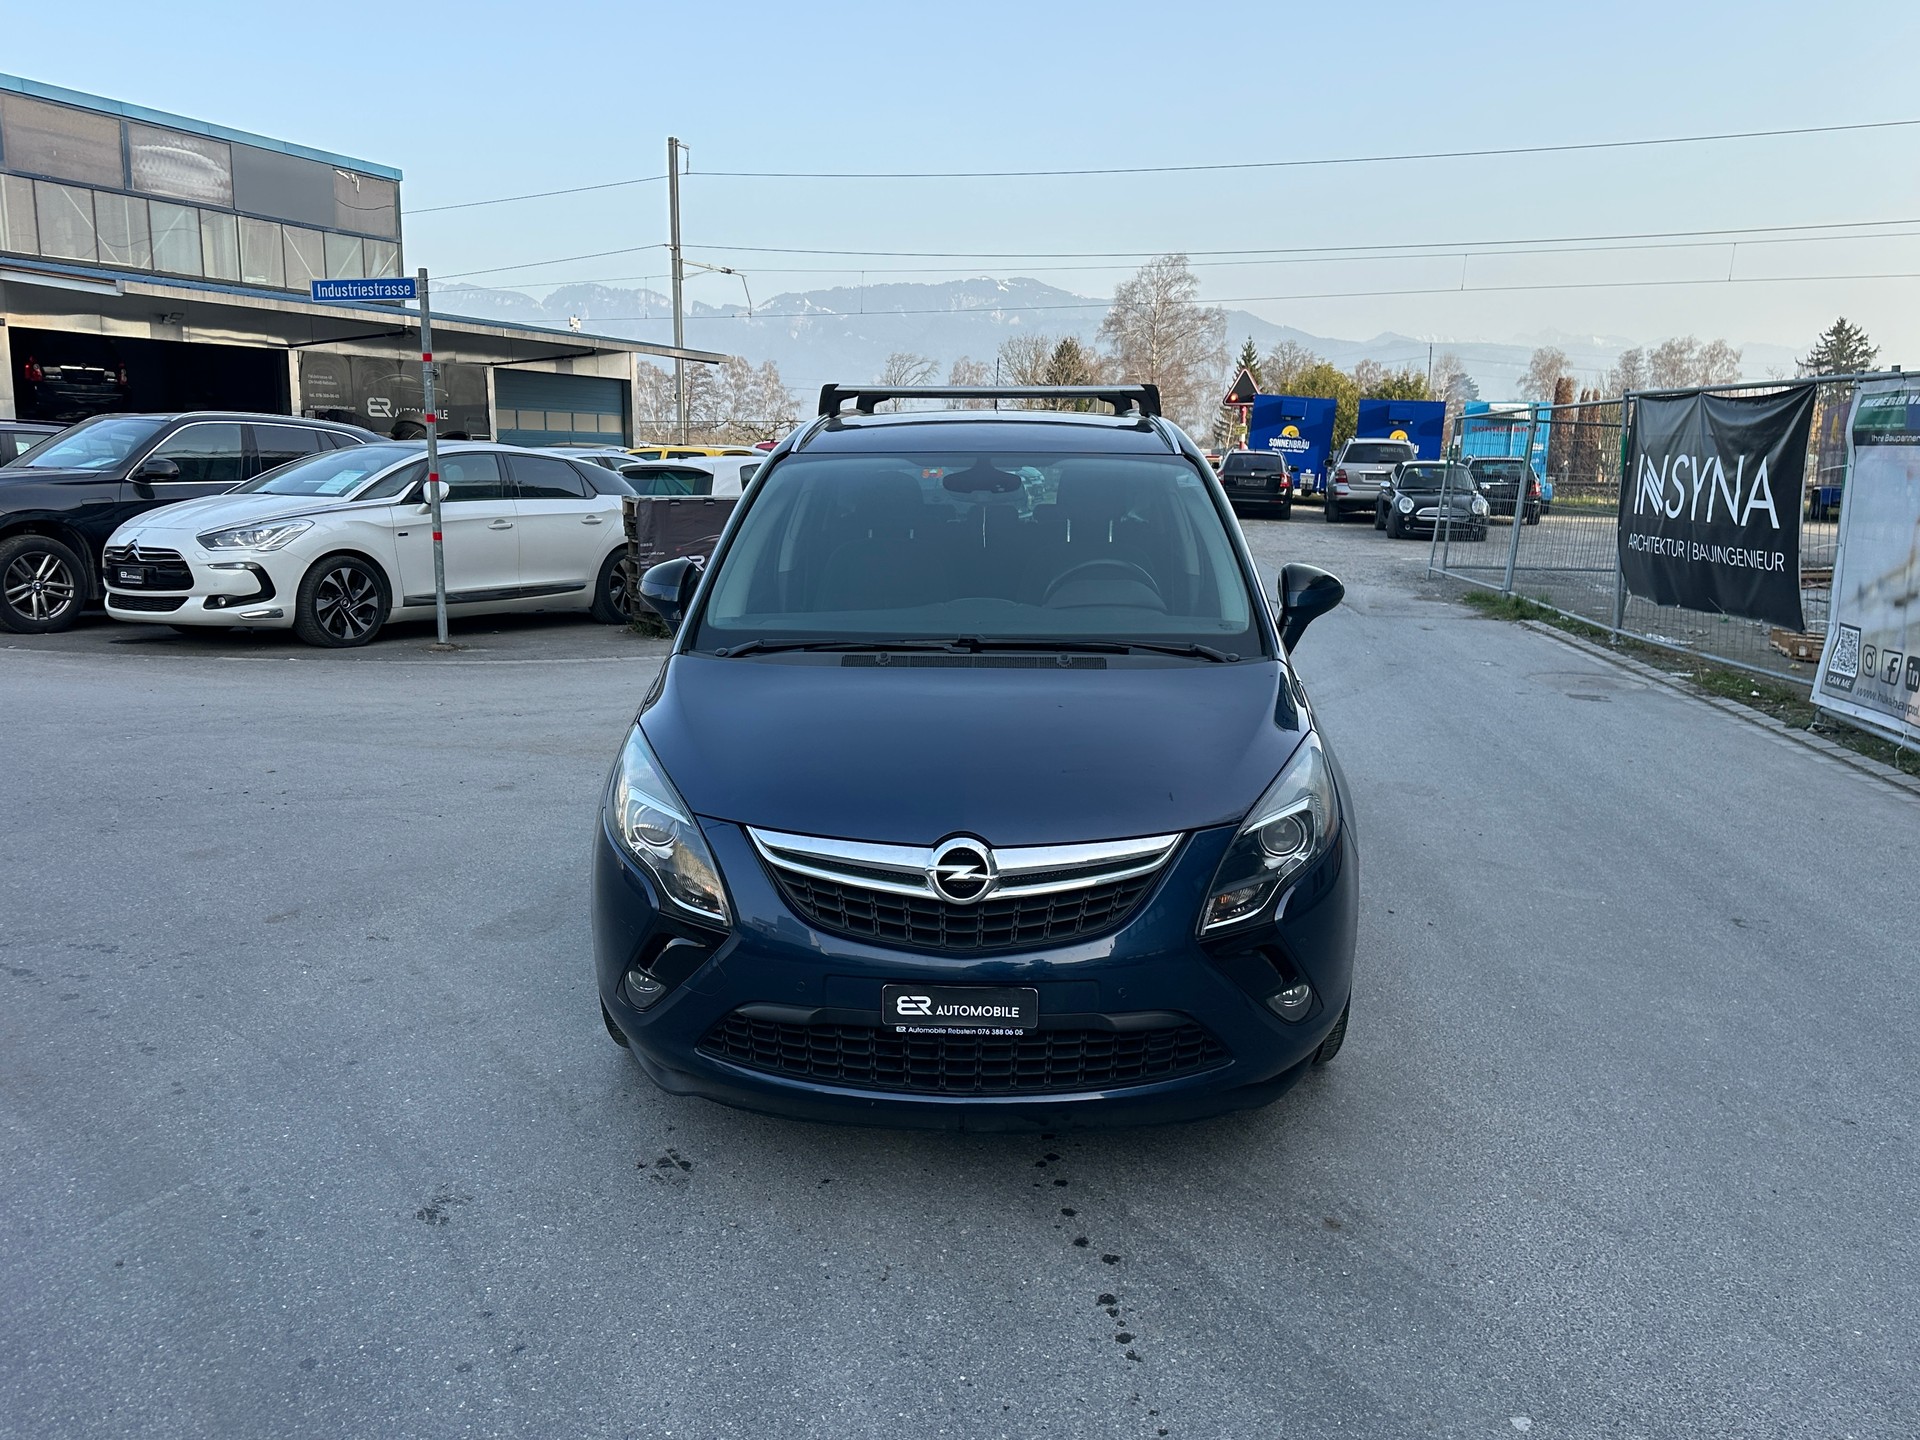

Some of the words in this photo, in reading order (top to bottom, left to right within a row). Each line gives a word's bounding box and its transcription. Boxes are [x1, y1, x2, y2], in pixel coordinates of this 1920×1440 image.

[317, 283, 411, 298] Industriestrasse
[1627, 532, 1685, 558] ARCHITEKTUR
[1692, 542, 1785, 572] BAUINGENIEUR
[1826, 674, 1841, 687] SCAN
[1840, 676, 1852, 689] ME
[935, 1005, 1020, 1018] AUTOMOBILE
[1004, 1028, 1014, 1036] 06
[1014, 1028, 1024, 1036] 05
